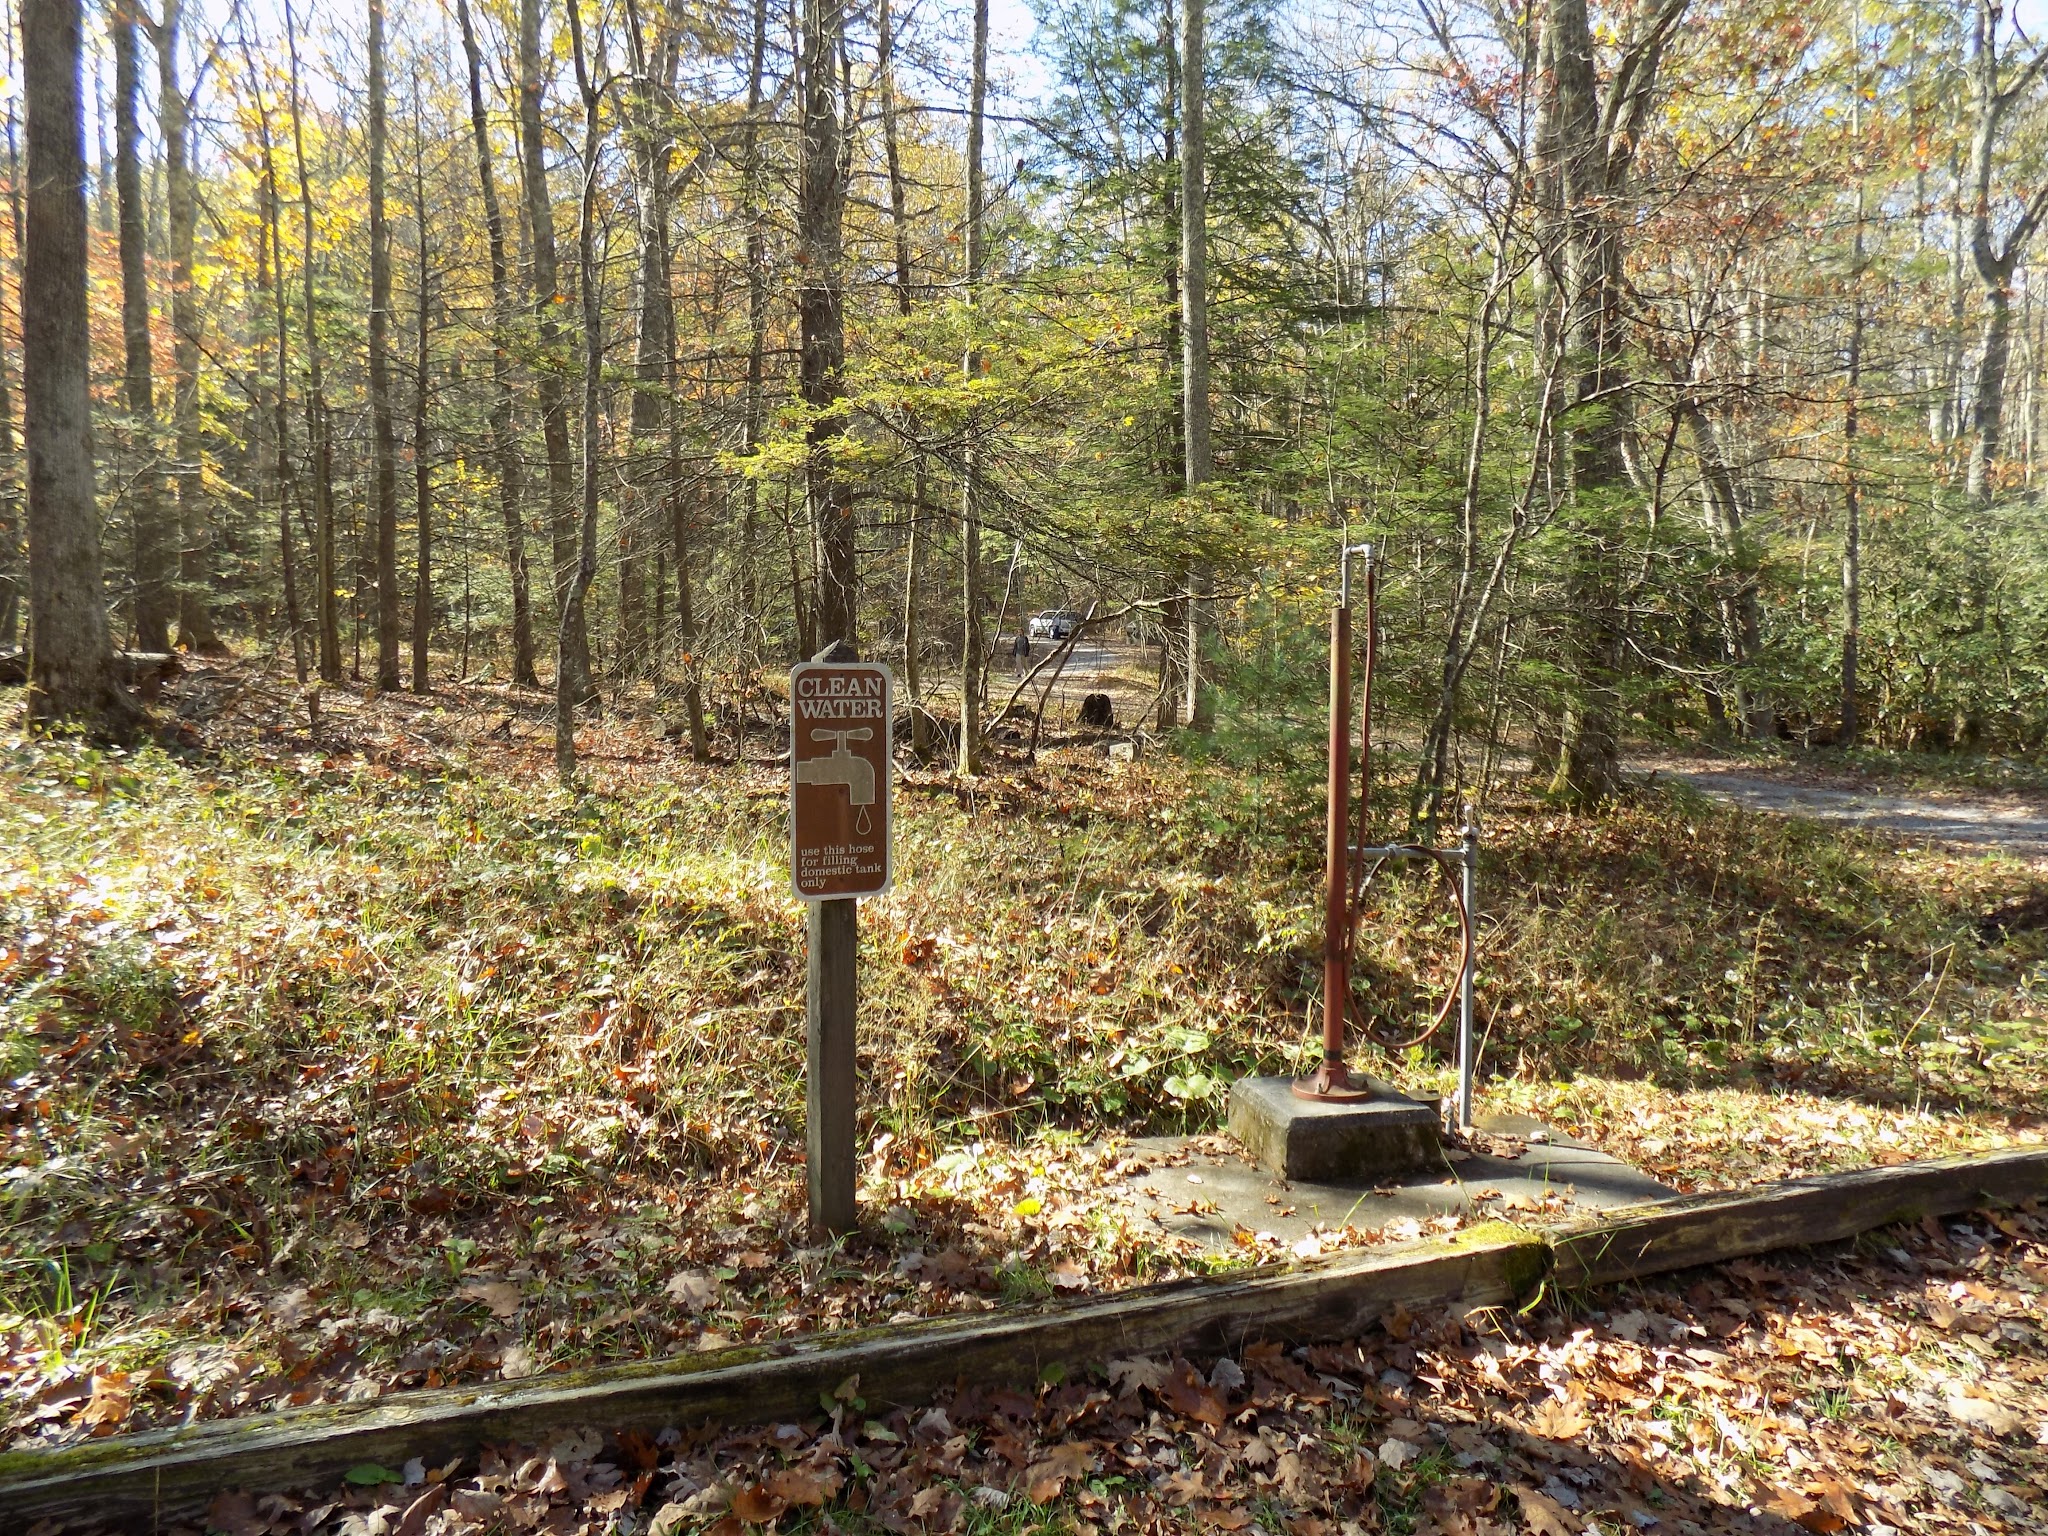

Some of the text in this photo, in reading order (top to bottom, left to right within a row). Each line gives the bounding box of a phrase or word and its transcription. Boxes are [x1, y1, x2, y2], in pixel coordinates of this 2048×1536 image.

[797, 677, 883, 698] CLEAN
[797, 699, 884, 719] WATER
[800, 843, 874, 856] use this hose
[800, 855, 858, 867] for filling
[800, 863, 882, 877] domestic tank
[800, 876, 827, 889] only
